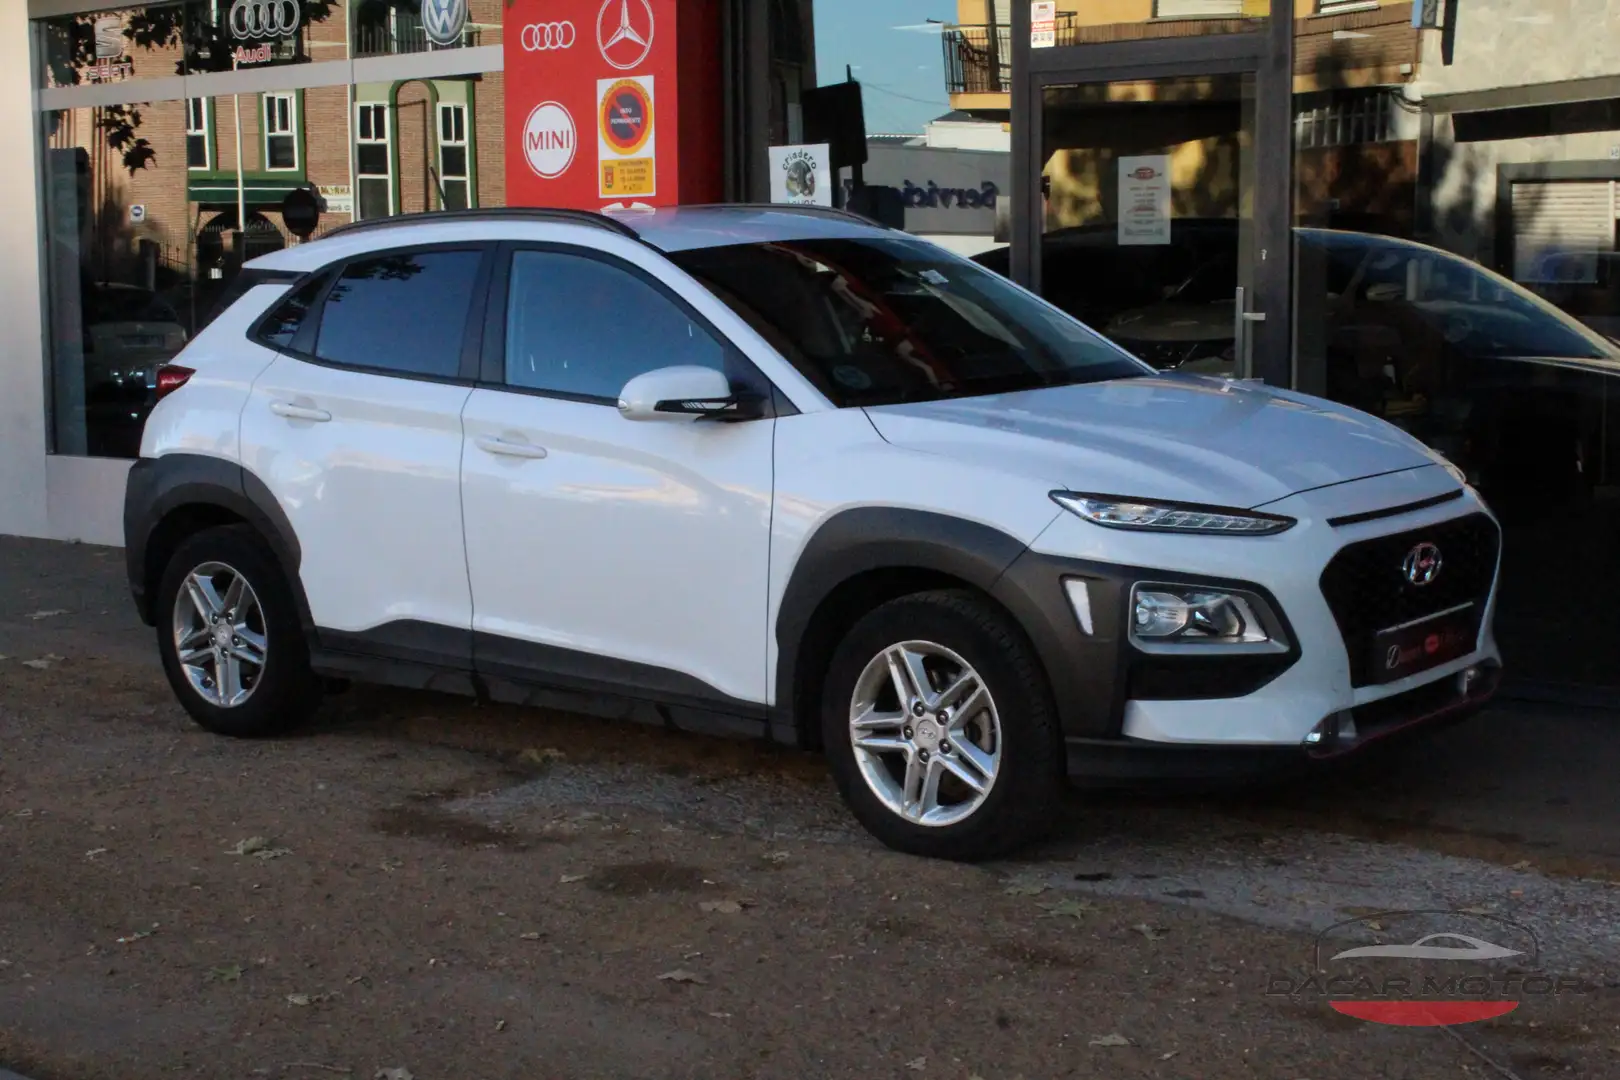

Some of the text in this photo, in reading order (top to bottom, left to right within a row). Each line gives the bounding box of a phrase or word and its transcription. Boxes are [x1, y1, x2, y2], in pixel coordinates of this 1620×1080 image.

[234, 43, 271, 62] Audi
[88, 63, 132, 80] SEAT
[528, 129, 570, 151] MINI
